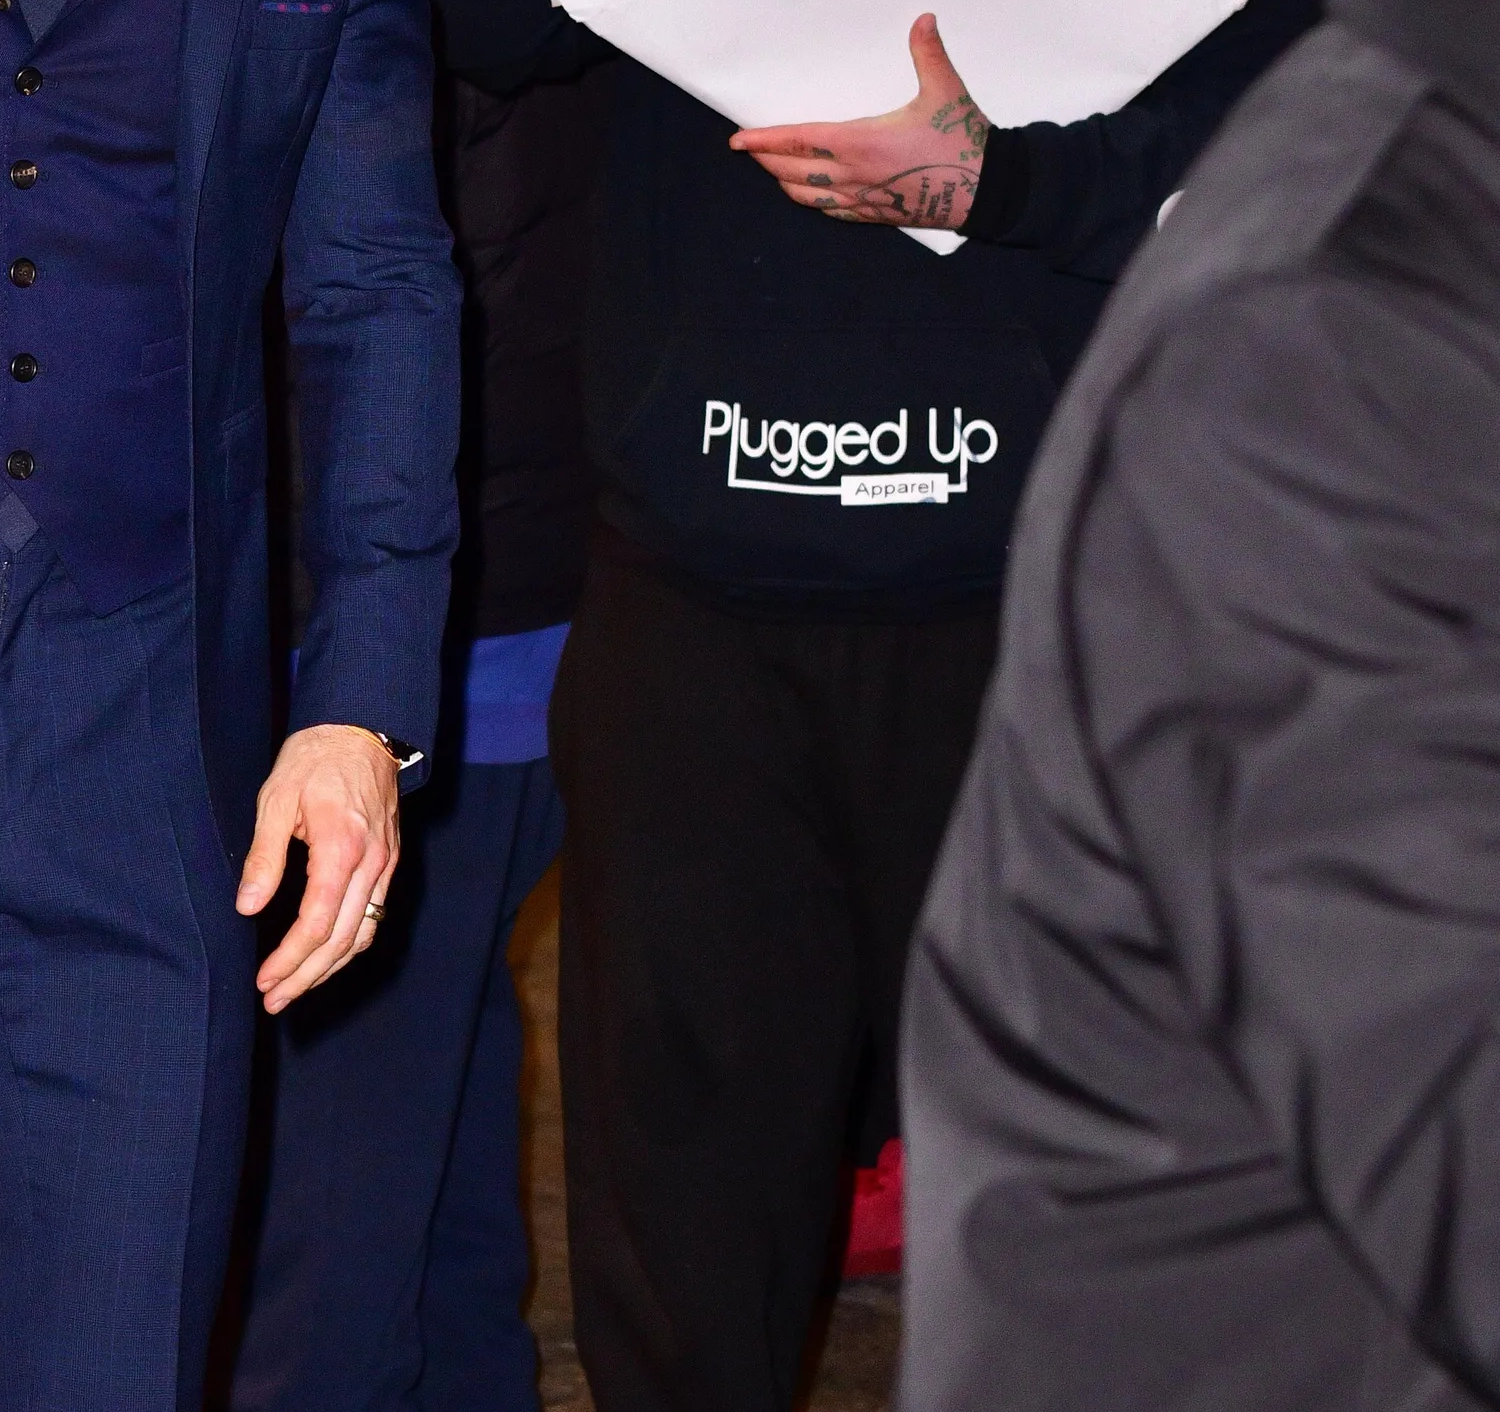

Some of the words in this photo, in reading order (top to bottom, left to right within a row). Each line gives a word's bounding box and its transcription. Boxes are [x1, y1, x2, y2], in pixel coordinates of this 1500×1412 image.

[702, 400, 908, 483] Plugged
[928, 407, 998, 490] Up
[854, 480, 935, 499] Apparel
